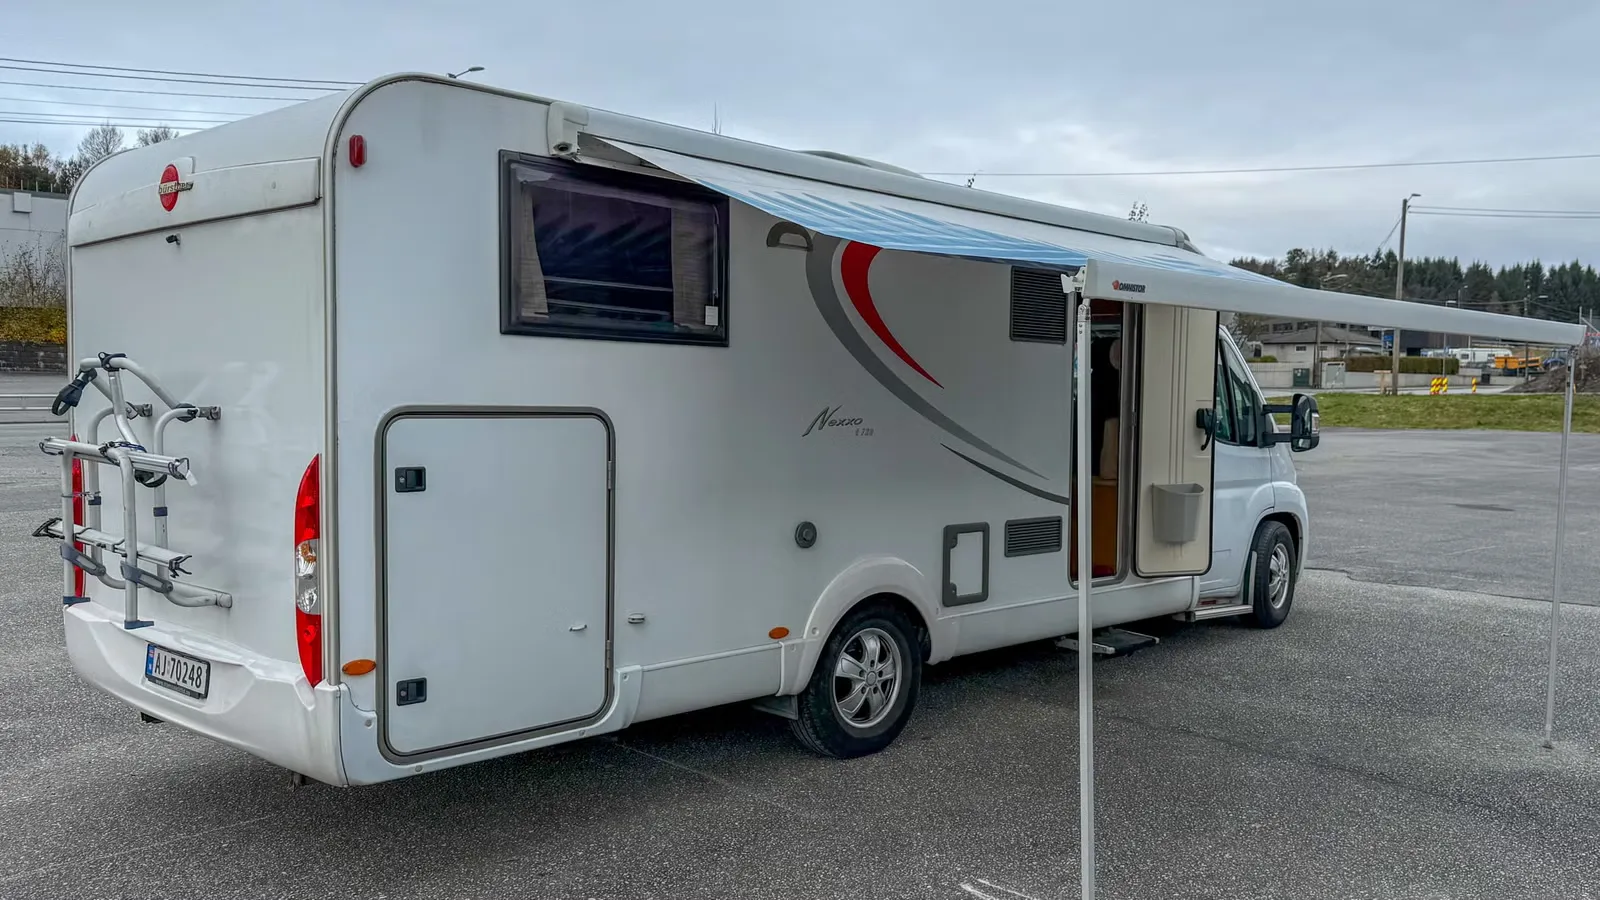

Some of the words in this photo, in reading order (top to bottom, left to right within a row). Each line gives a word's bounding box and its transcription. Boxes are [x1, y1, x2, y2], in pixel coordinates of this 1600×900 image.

[1119, 282, 1146, 293] OMNISTOR
[801, 404, 863, 437] Nexxo
[154, 652, 167, 676] AJ
[170, 657, 203, 688] 70248
